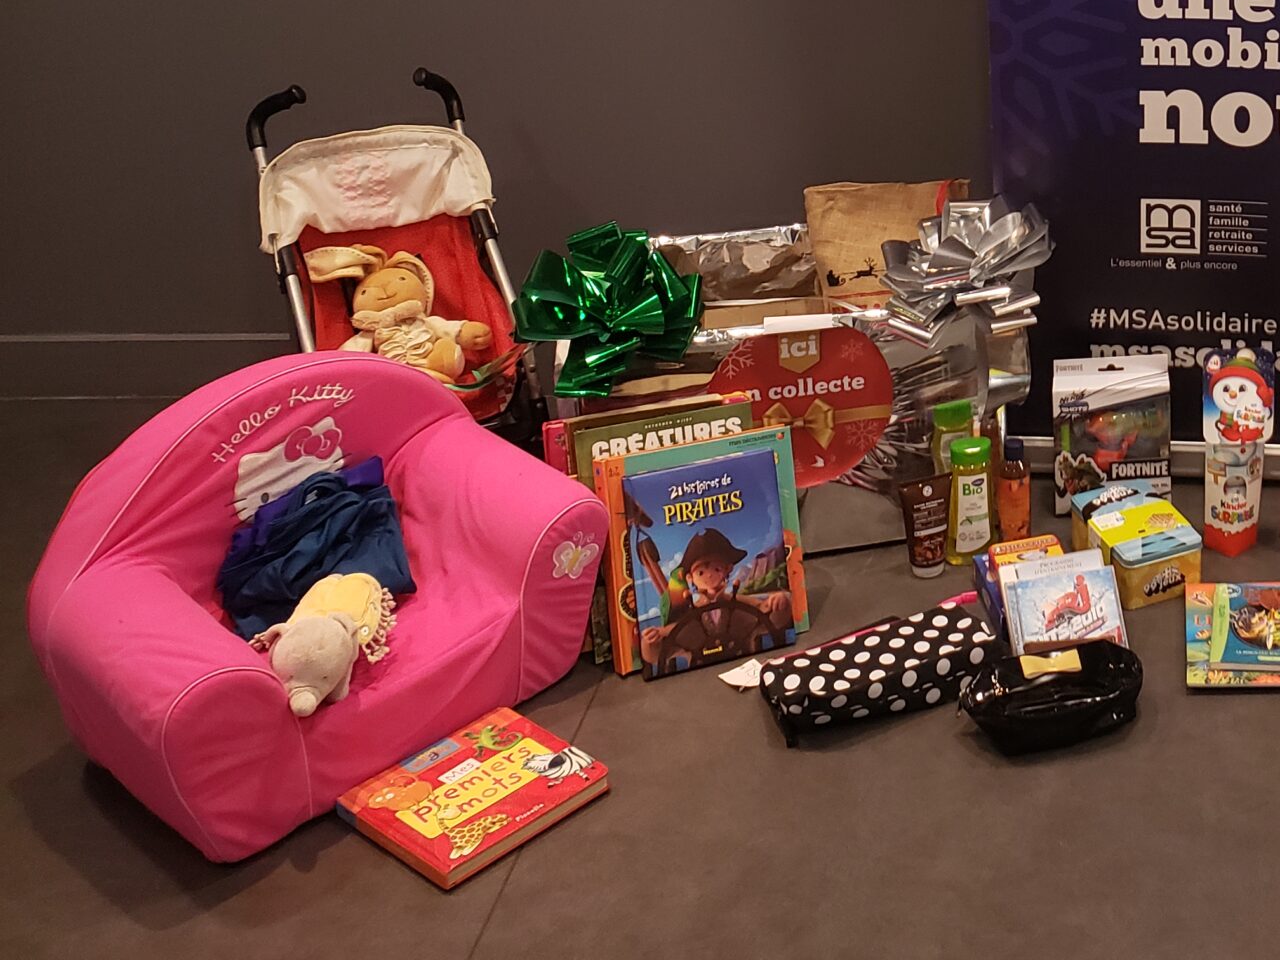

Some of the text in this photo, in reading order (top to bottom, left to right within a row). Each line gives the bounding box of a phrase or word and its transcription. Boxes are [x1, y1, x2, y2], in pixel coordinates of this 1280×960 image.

[1209, 204, 1242, 213] santé
[1209, 216, 1249, 226] famille
[1209, 230, 1253, 240] retraite
[1209, 243, 1259, 253] services
[1110, 257, 1238, 271] L'essentiel & plus encore
[1090, 308, 1278, 334] #MSAsolidaire
[780, 335, 818, 359] ici
[769, 375, 865, 401] collecte
[211, 383, 356, 463] Hello Kitty
[1111, 460, 1169, 479] FORTNITE
[683, 477, 720, 495] histoires
[721, 473, 731, 486] de
[663, 490, 743, 525] PIRATES
[445, 762, 475, 781] Mes
[413, 746, 532, 823] premiers
[455, 772, 523, 813] mots
